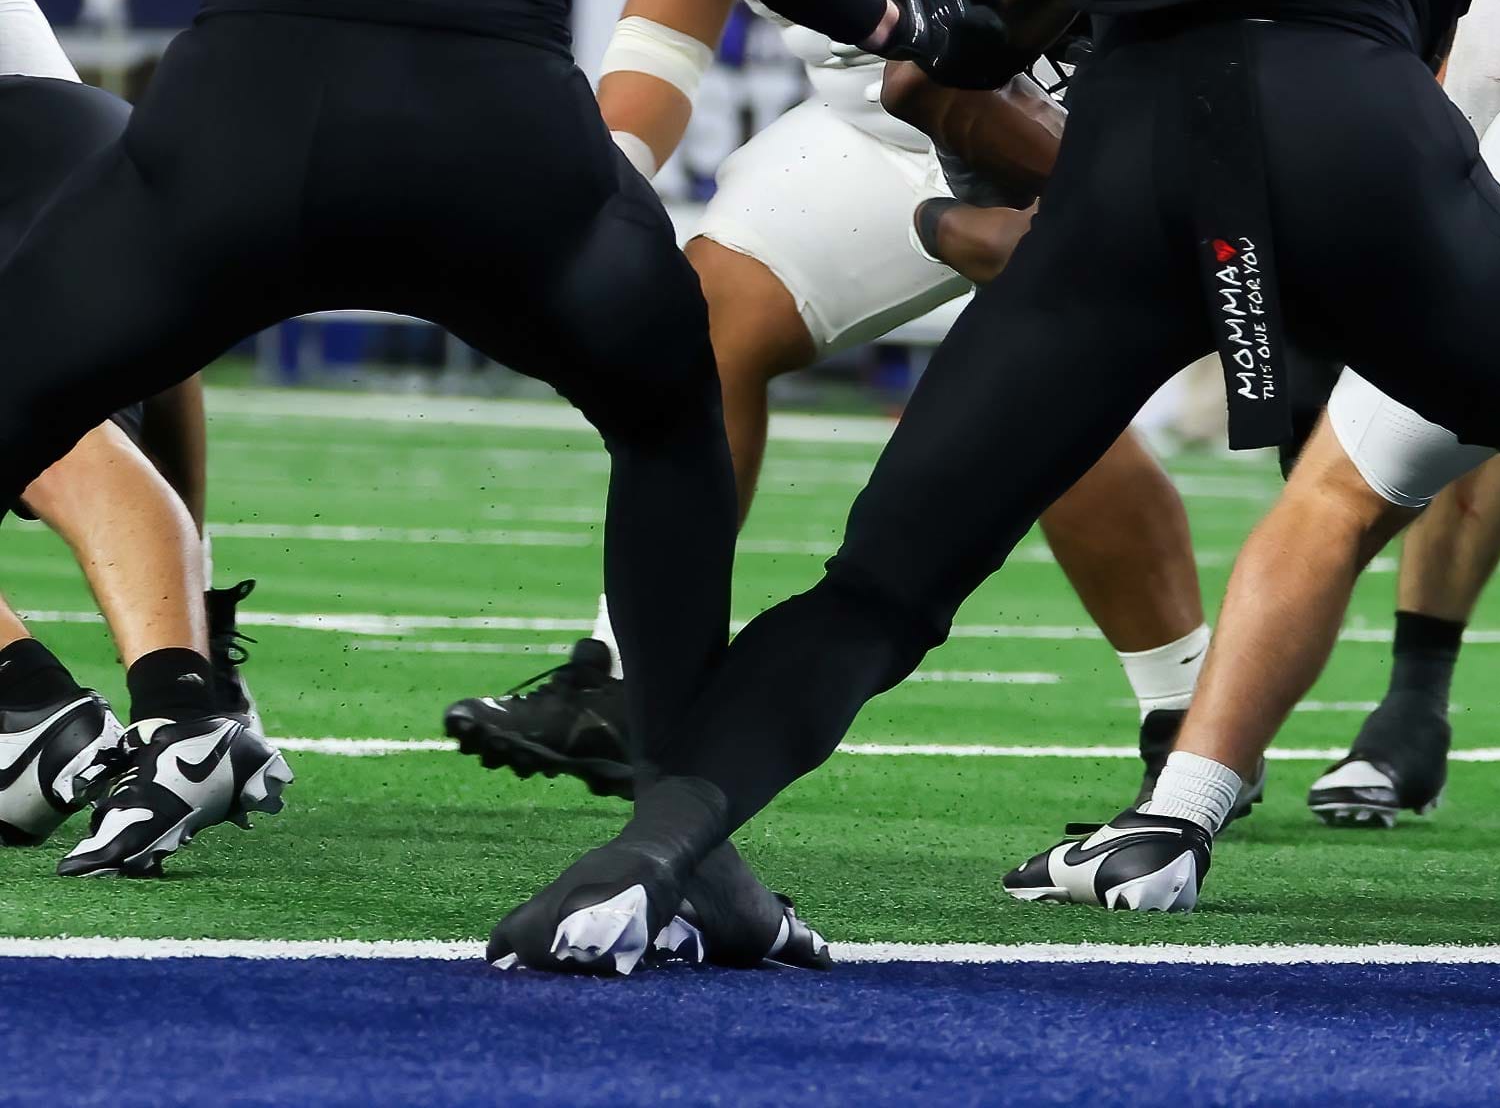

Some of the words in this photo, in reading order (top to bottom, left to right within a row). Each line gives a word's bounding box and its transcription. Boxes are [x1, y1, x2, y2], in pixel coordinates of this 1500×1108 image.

[1238, 236, 1261, 274] YOU
[1246, 277, 1265, 315] FOR
[1215, 265, 1259, 400] MOMMA
[1254, 321, 1271, 359] ONE
[1260, 363, 1275, 400] THIS
